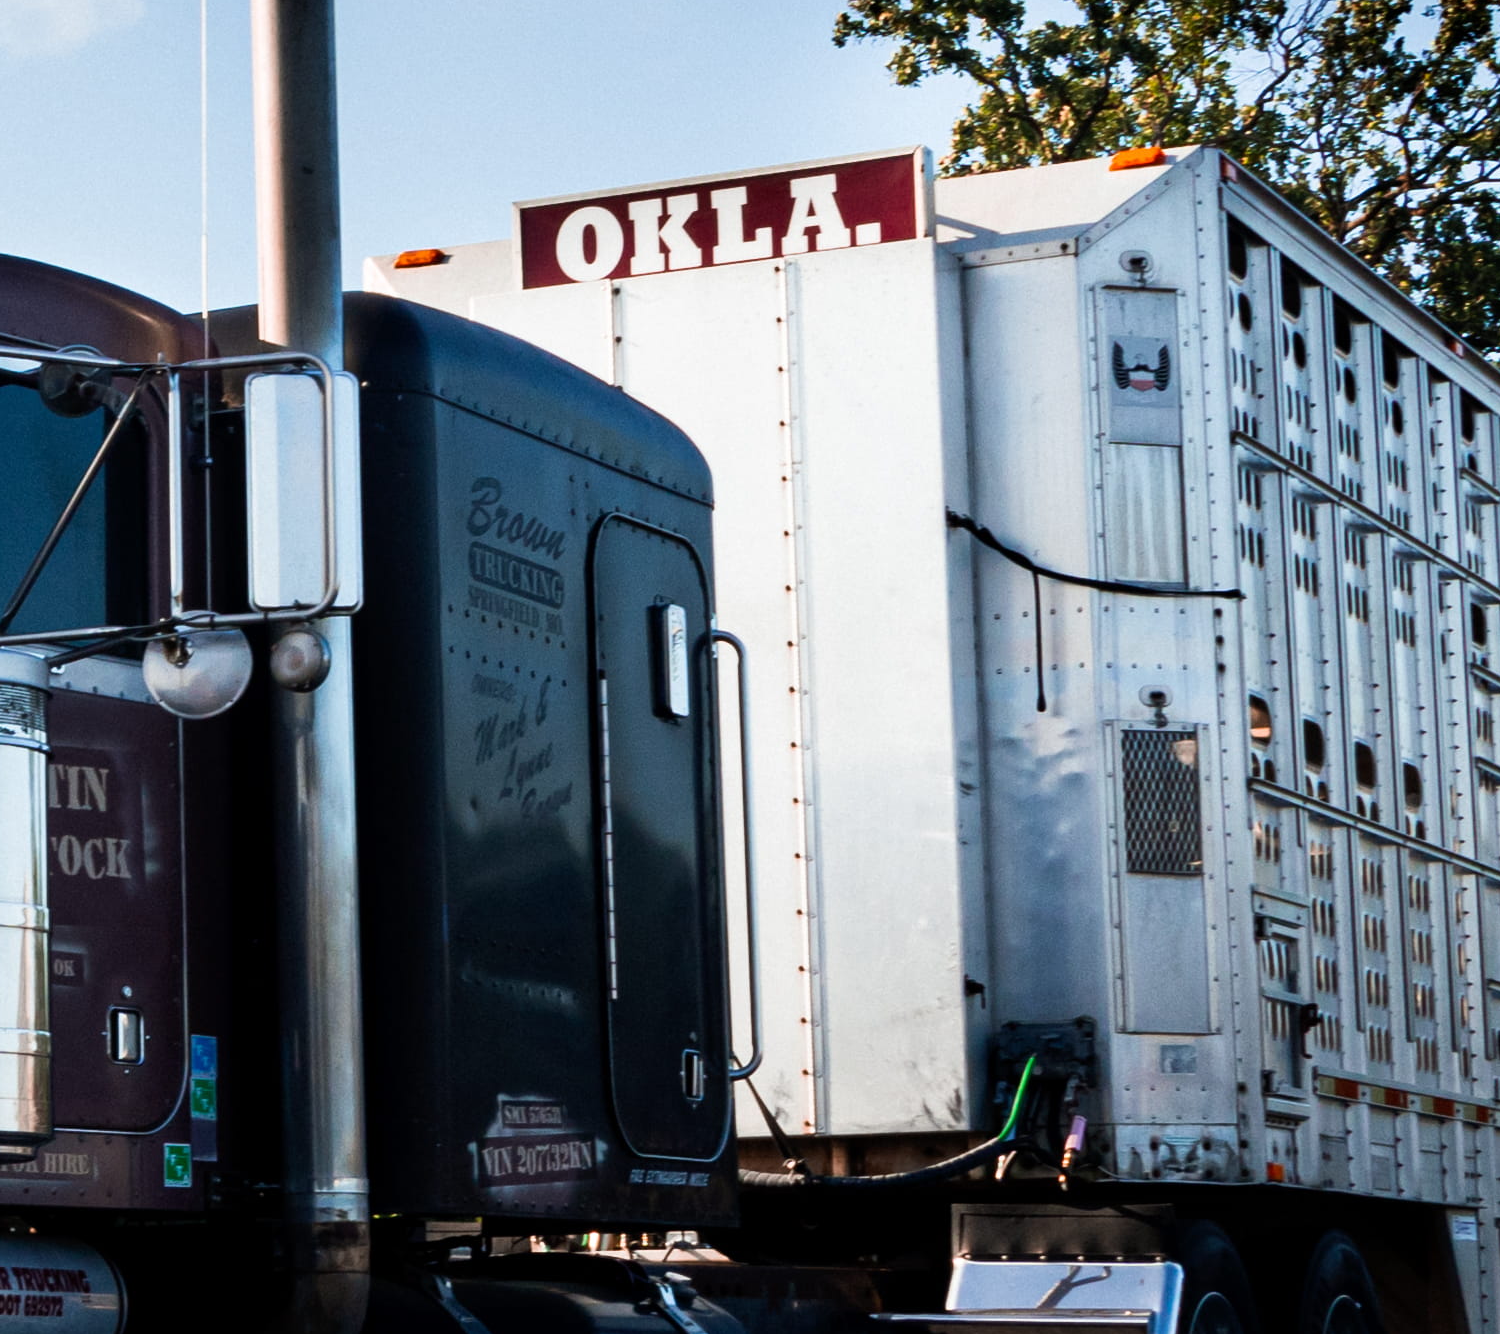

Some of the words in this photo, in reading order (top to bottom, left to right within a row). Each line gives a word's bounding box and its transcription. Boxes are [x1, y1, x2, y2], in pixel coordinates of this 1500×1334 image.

[555, 173, 882, 283] OKLA.
[466, 476, 566, 560] Brown
[471, 547, 564, 604] TRUCKING
[51, 834, 132, 880] OCK
[43, 1152, 91, 1176] HIRE
[481, 1145, 513, 1177] VIN
[11, 1266, 91, 1294] TRUCKING
